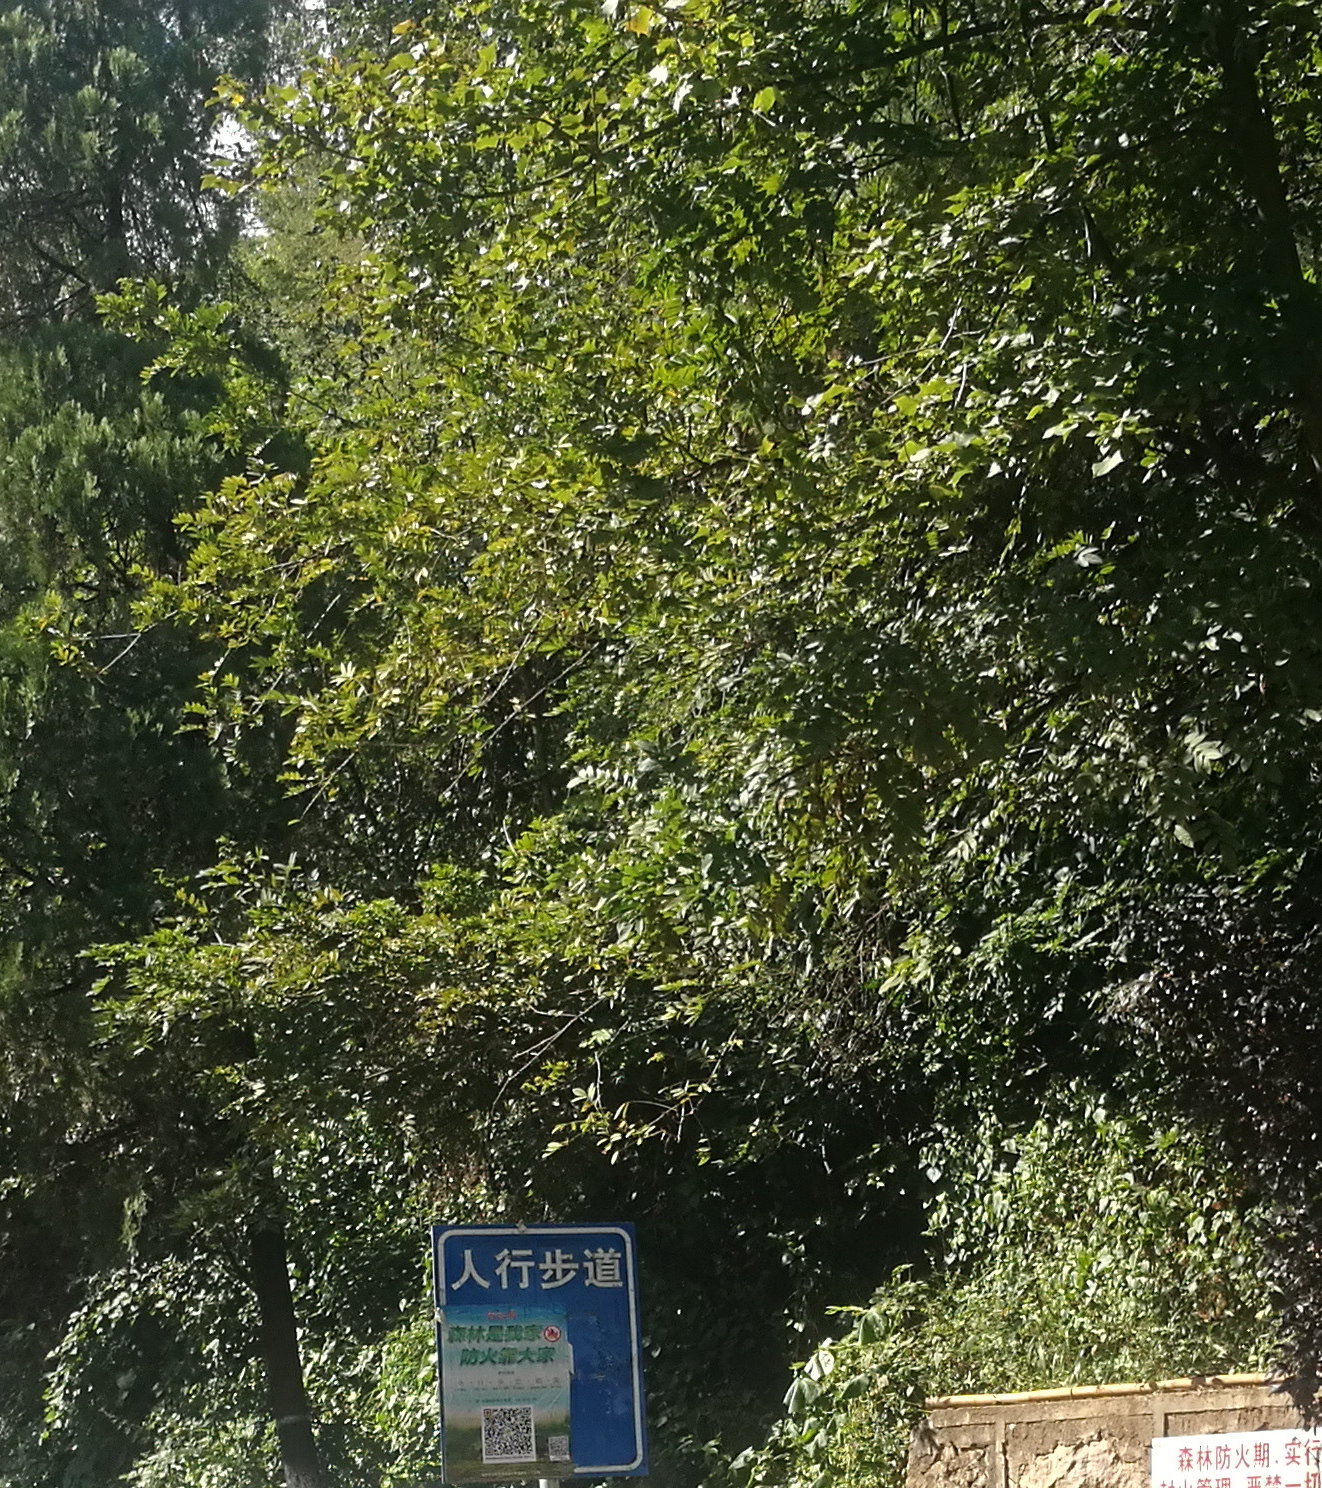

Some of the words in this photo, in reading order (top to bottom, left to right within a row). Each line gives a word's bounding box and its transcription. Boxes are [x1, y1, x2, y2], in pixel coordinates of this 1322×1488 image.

[451, 1247, 624, 1291] 人行步道
[448, 1325, 543, 1343] 森林是我家
